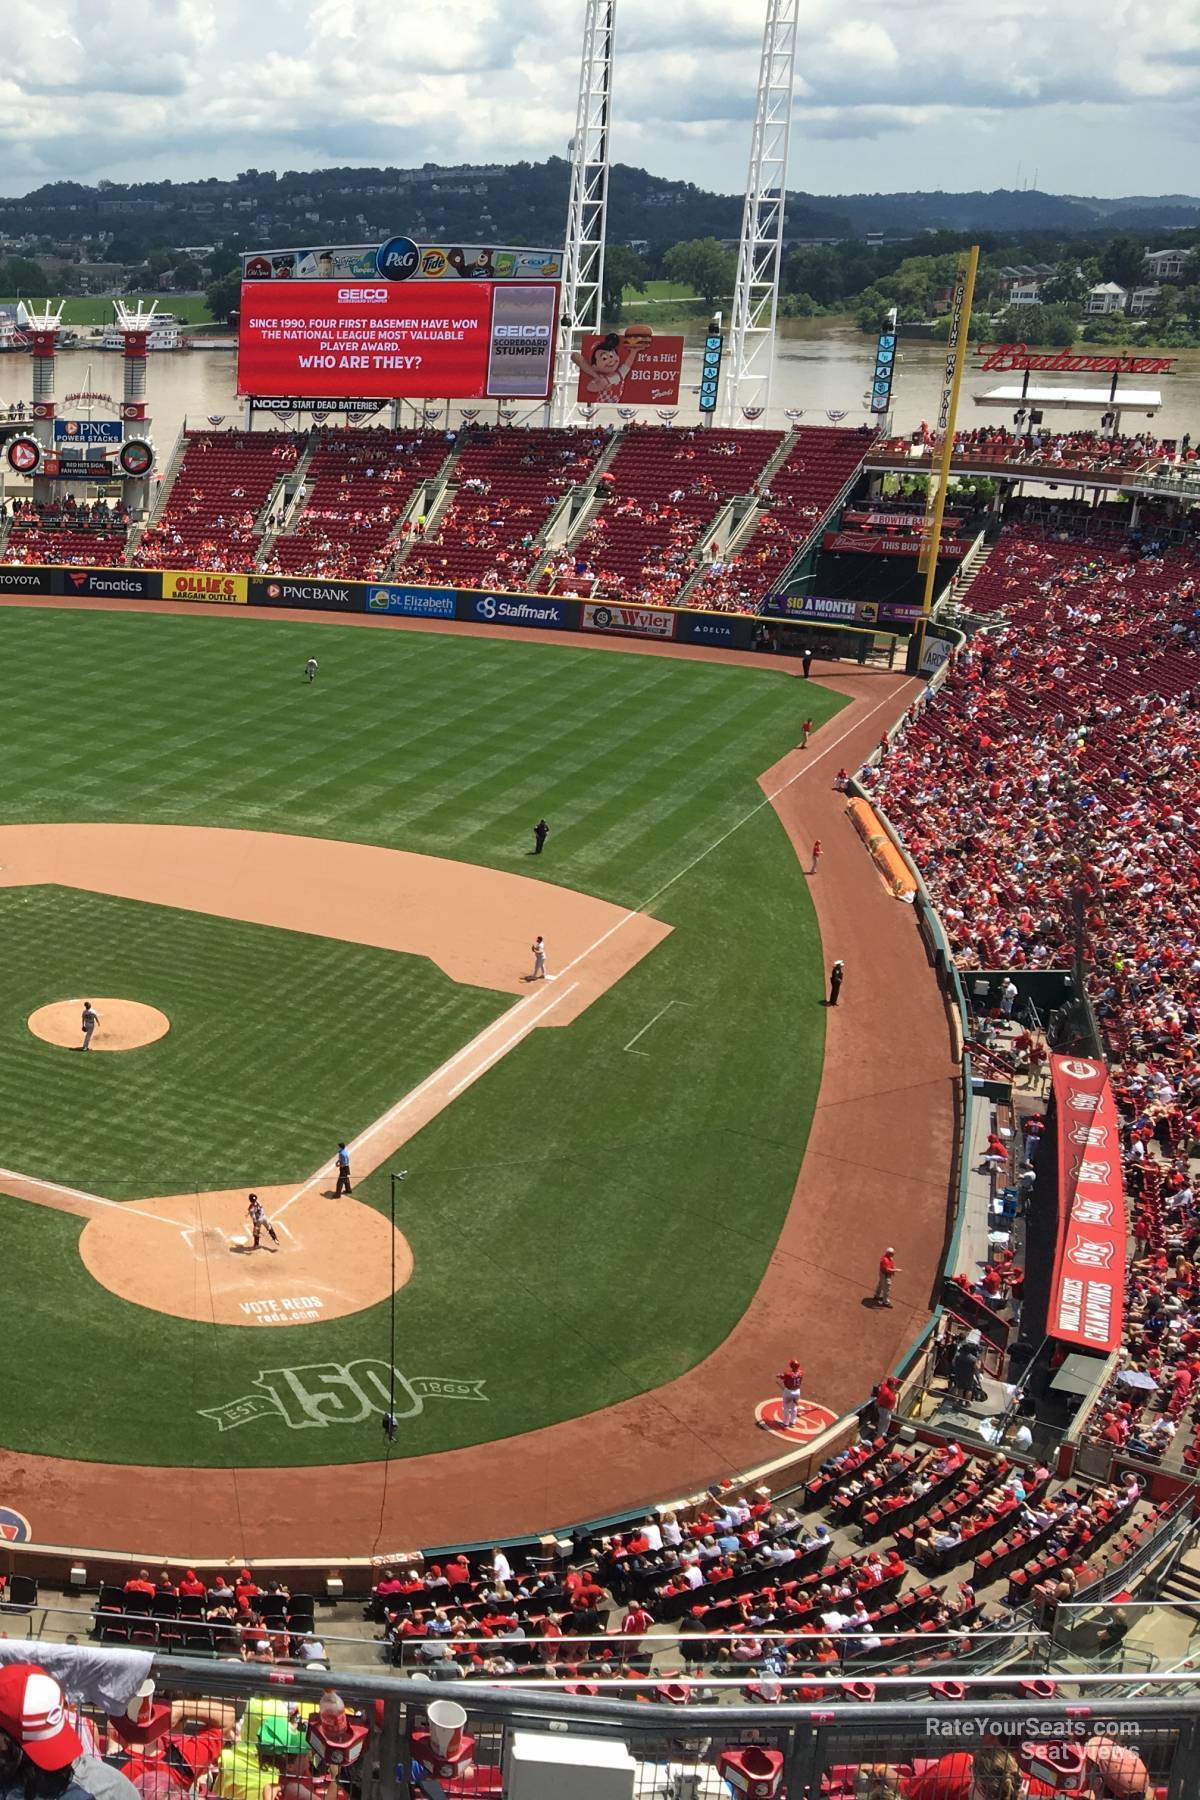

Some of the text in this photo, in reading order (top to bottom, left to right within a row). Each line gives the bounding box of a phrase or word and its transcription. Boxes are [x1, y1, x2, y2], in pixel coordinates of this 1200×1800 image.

[386, 252, 415, 266] P&G
[422, 257, 445, 272] Tide
[338, 289, 388, 299] GEICO
[249, 319, 478, 329] SINCE 1990, FOUR FIRST BASEMEN HAVE WON
[262, 330, 464, 340] THE NATIONAL LEAGUE MOST VALUABLE
[494, 326, 549, 337] GEICO
[320, 342, 400, 351] PLAYER AWARD.
[495, 346, 545, 355] STUMPER
[299, 356, 422, 369] WHO ARE THEY?
[638, 353, 651, 361] It's
[978, 343, 1175, 374] Budweiser
[631, 370, 676, 381] BIG BOY
[253, 400, 380, 410] NOCO START DEAD BATTERIES.
[939, 390, 951, 428] FAIR
[80, 423, 111, 436] PNC
[882, 542, 896, 550] THIS
[901, 543, 925, 551] BUD'S
[0, 575, 41, 586] TOYOTA
[89, 577, 143, 592] Fanatics
[175, 576, 234, 595] OLLIE'S
[172, 591, 237, 601] BARGAIN OUTLET
[404, 595, 453, 609] Elizabeth
[498, 602, 558, 621] Staffmark
[787, 597, 856, 614] $10 A MONTH
[620, 610, 671, 627] Wyler
[703, 626, 731, 635] DELTA
[1073, 1242, 1110, 1266] 1919
[239, 1296, 323, 1315] VOTE REDS
[1059, 1277, 1083, 1332] WORLD SERIES
[1084, 1281, 1112, 1342] CHAMPIONS
[256, 1310, 320, 1323] reds.com
[261, 1359, 422, 1428] 150
[419, 1380, 471, 1395] 1869
[224, 1402, 264, 1421] EST.
